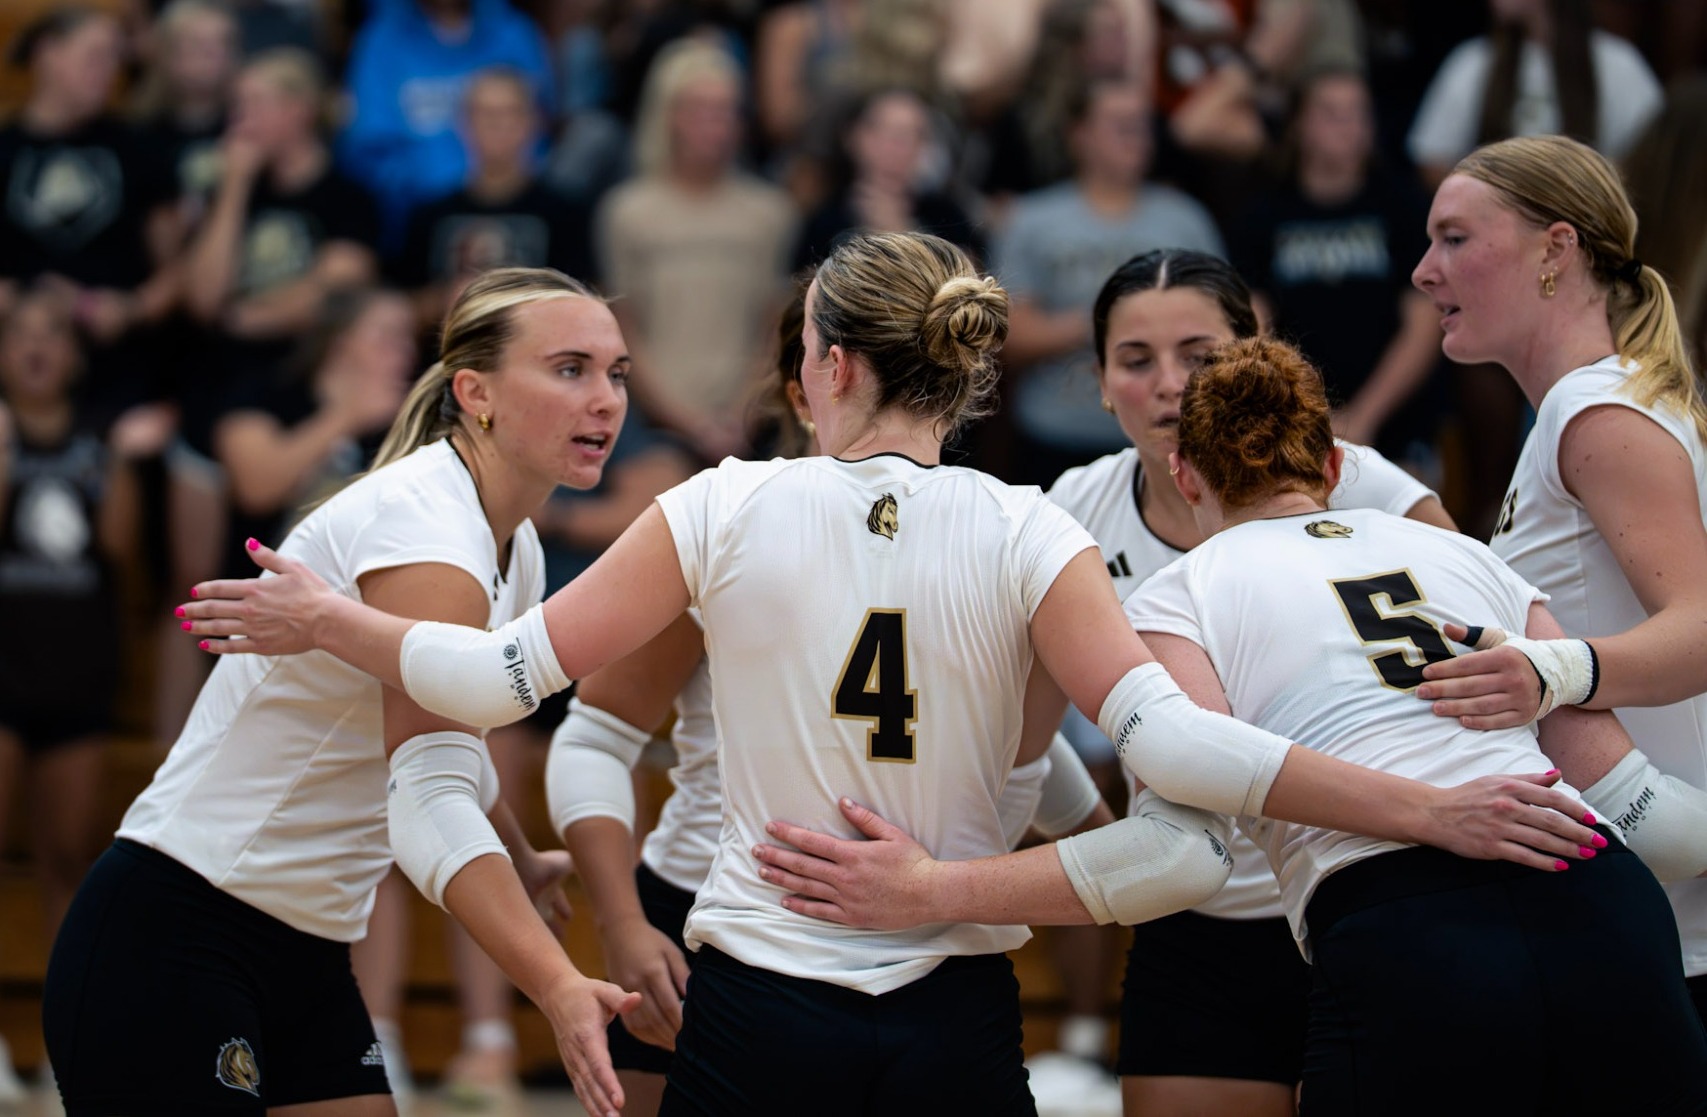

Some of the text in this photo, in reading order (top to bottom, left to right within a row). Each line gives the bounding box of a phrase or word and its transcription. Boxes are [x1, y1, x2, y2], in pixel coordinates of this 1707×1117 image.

[504, 636, 537, 712] Tandem
[1326, 567, 1457, 694] 5
[830, 607, 919, 764] 4
[1612, 786, 1655, 831] andem
